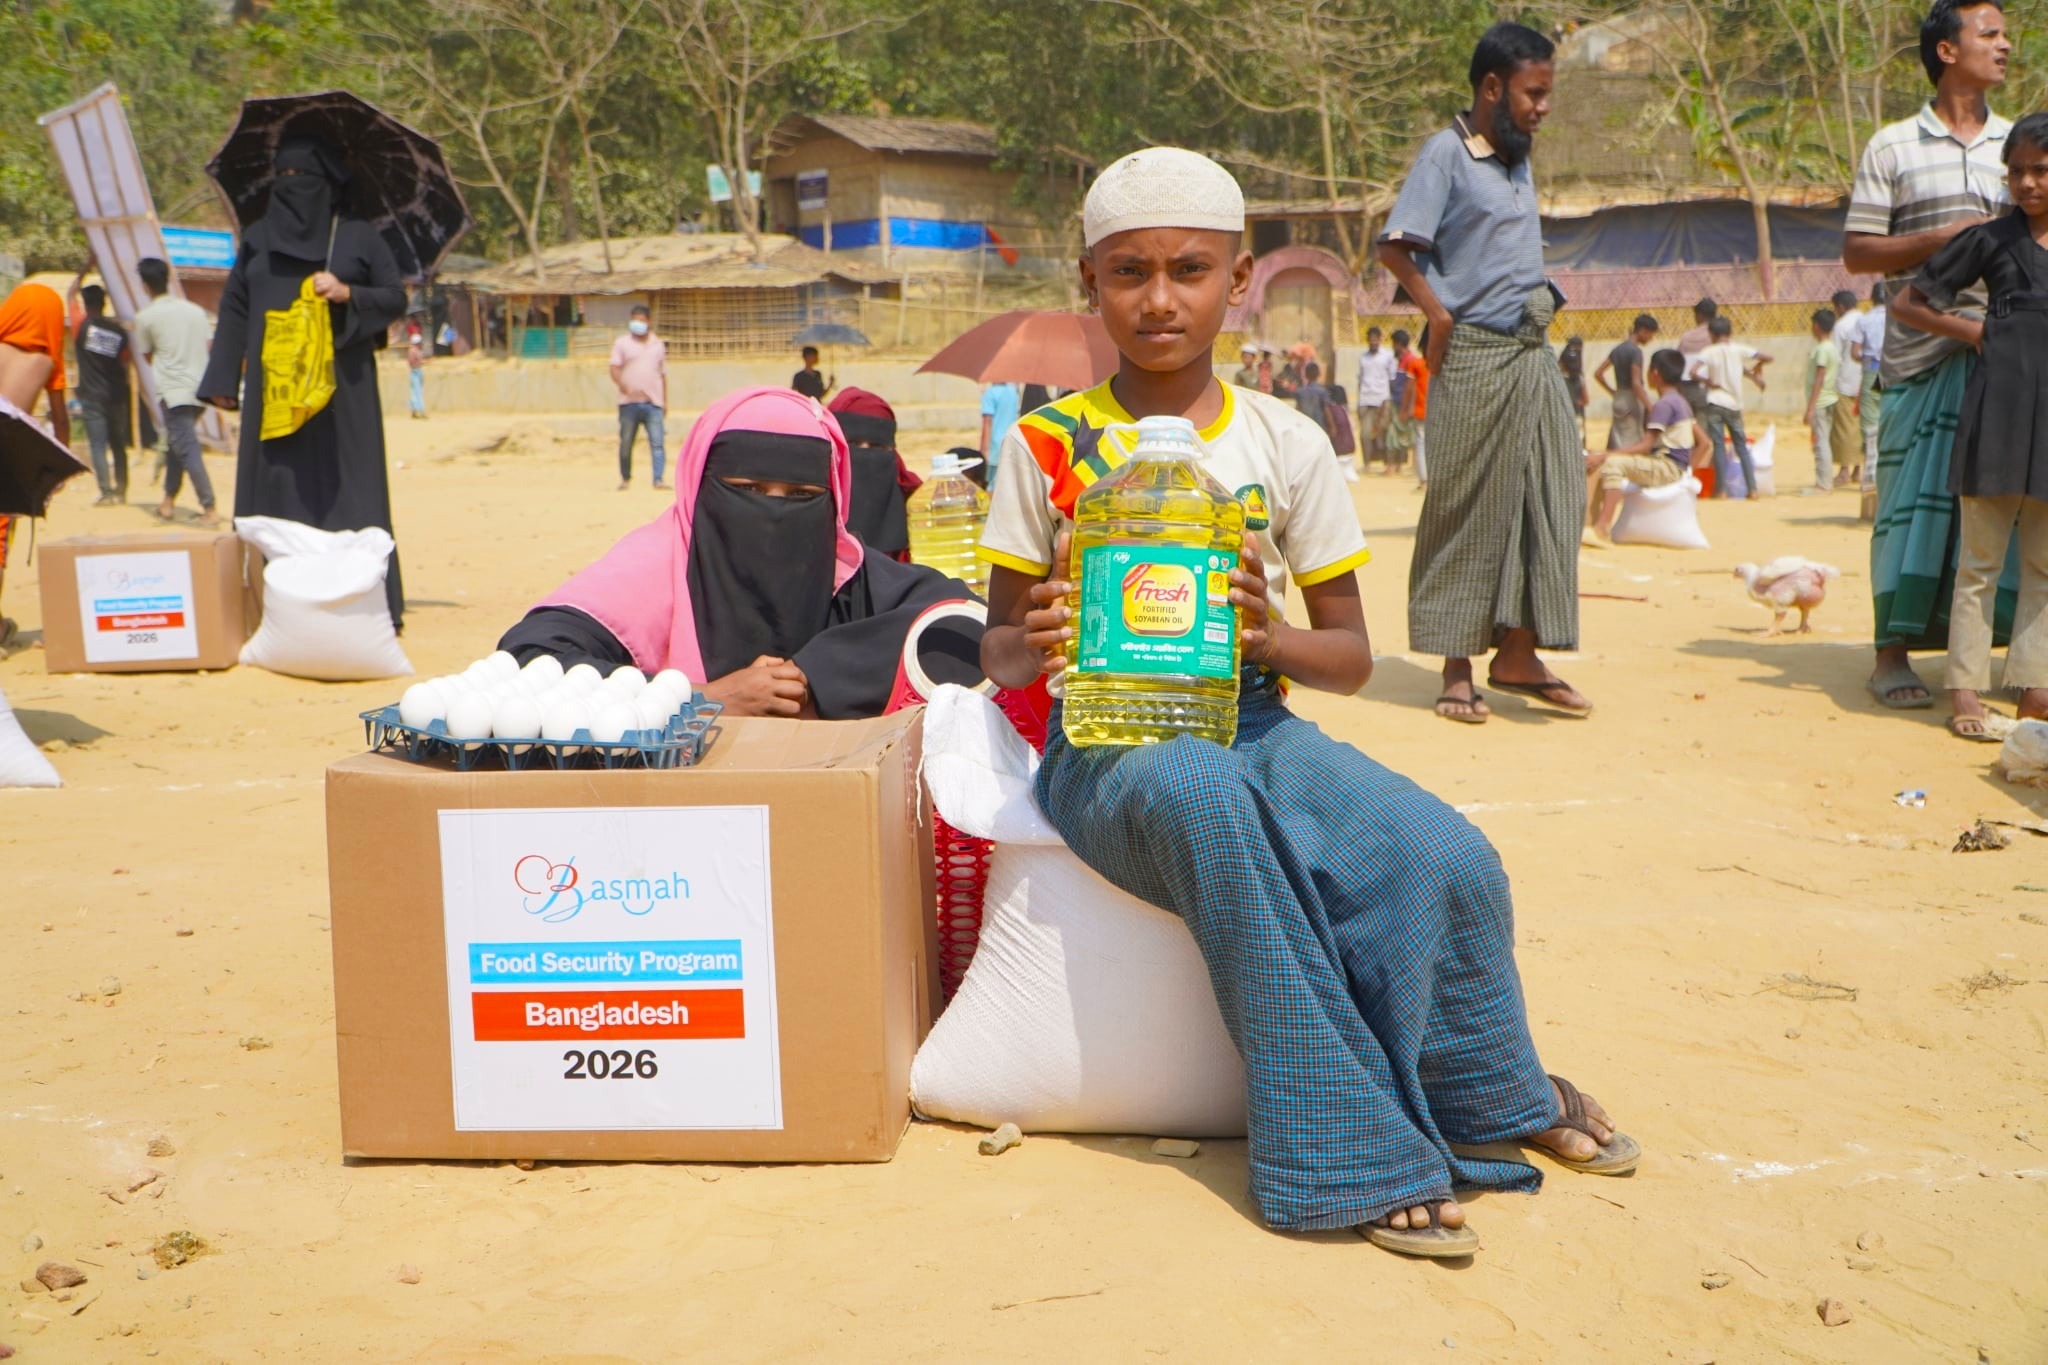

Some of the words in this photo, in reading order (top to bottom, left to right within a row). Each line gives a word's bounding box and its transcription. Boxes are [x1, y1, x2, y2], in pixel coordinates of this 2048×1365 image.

[1134, 580, 1189, 602] Fresh
[1134, 615, 1170, 623] SOYABEAN
[1172, 616, 1183, 624] OIL
[1142, 605, 1176, 614] FORTIFIED
[112, 615, 168, 628] Bangladesh
[127, 633, 158, 644] 2026
[515, 855, 690, 922] Basmah
[481, 953, 536, 973] Food
[542, 952, 634, 976] Security
[640, 951, 738, 975] Program
[525, 1000, 689, 1031] Bangladesh
[563, 1050, 658, 1079] 2026
